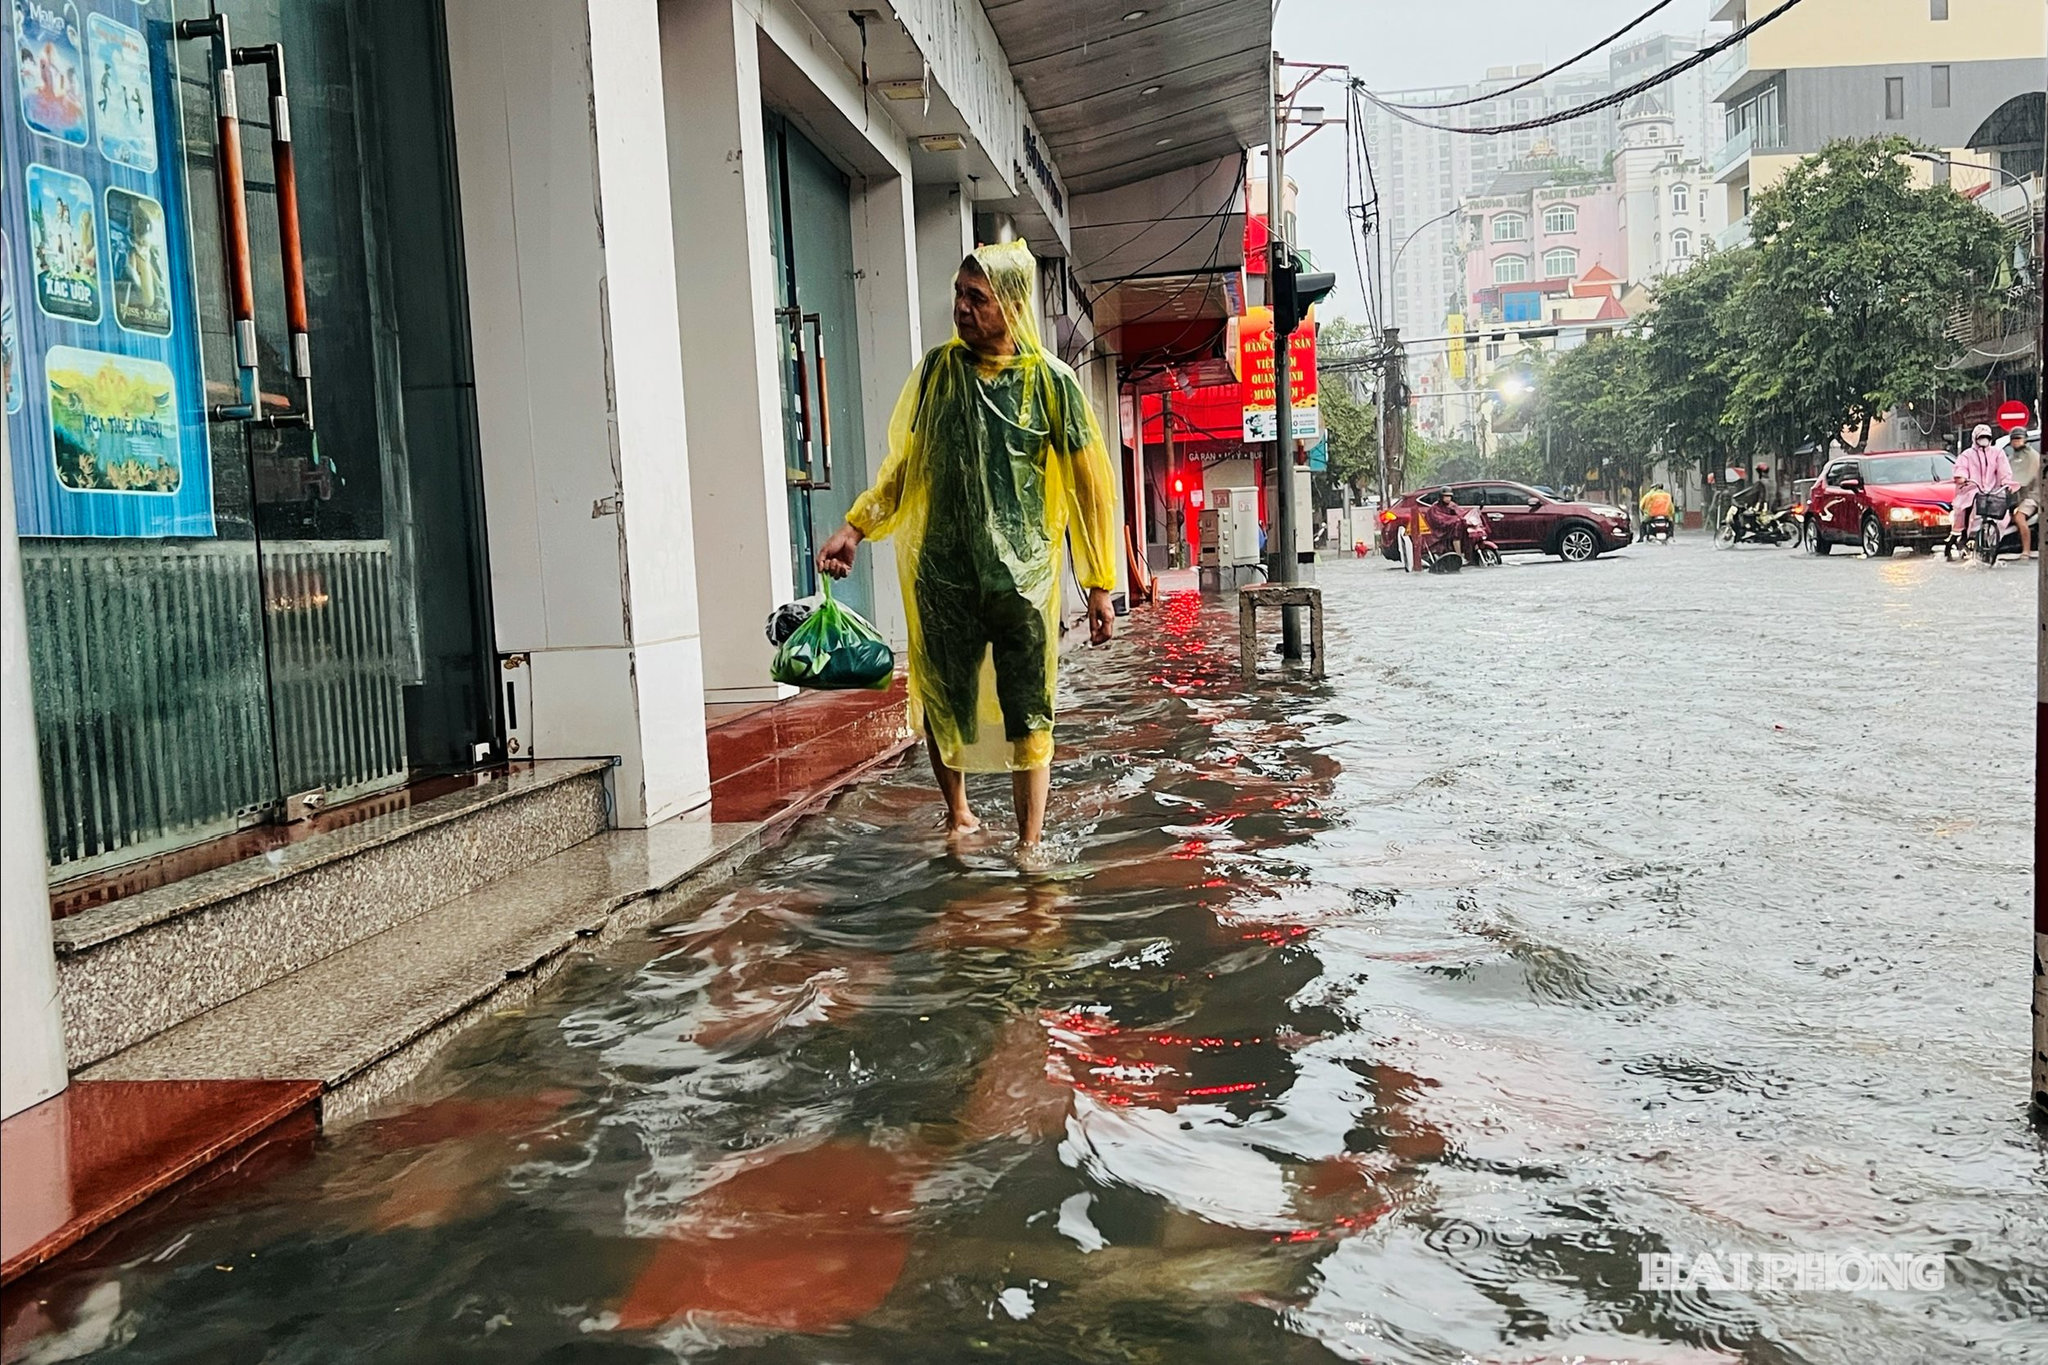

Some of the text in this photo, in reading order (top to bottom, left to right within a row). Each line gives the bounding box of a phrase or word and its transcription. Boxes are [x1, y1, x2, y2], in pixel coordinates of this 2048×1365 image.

[46, 277, 68, 297] XÁC
[1295, 335, 1311, 349] SẢN
[1252, 373, 1276, 384] QUAN
